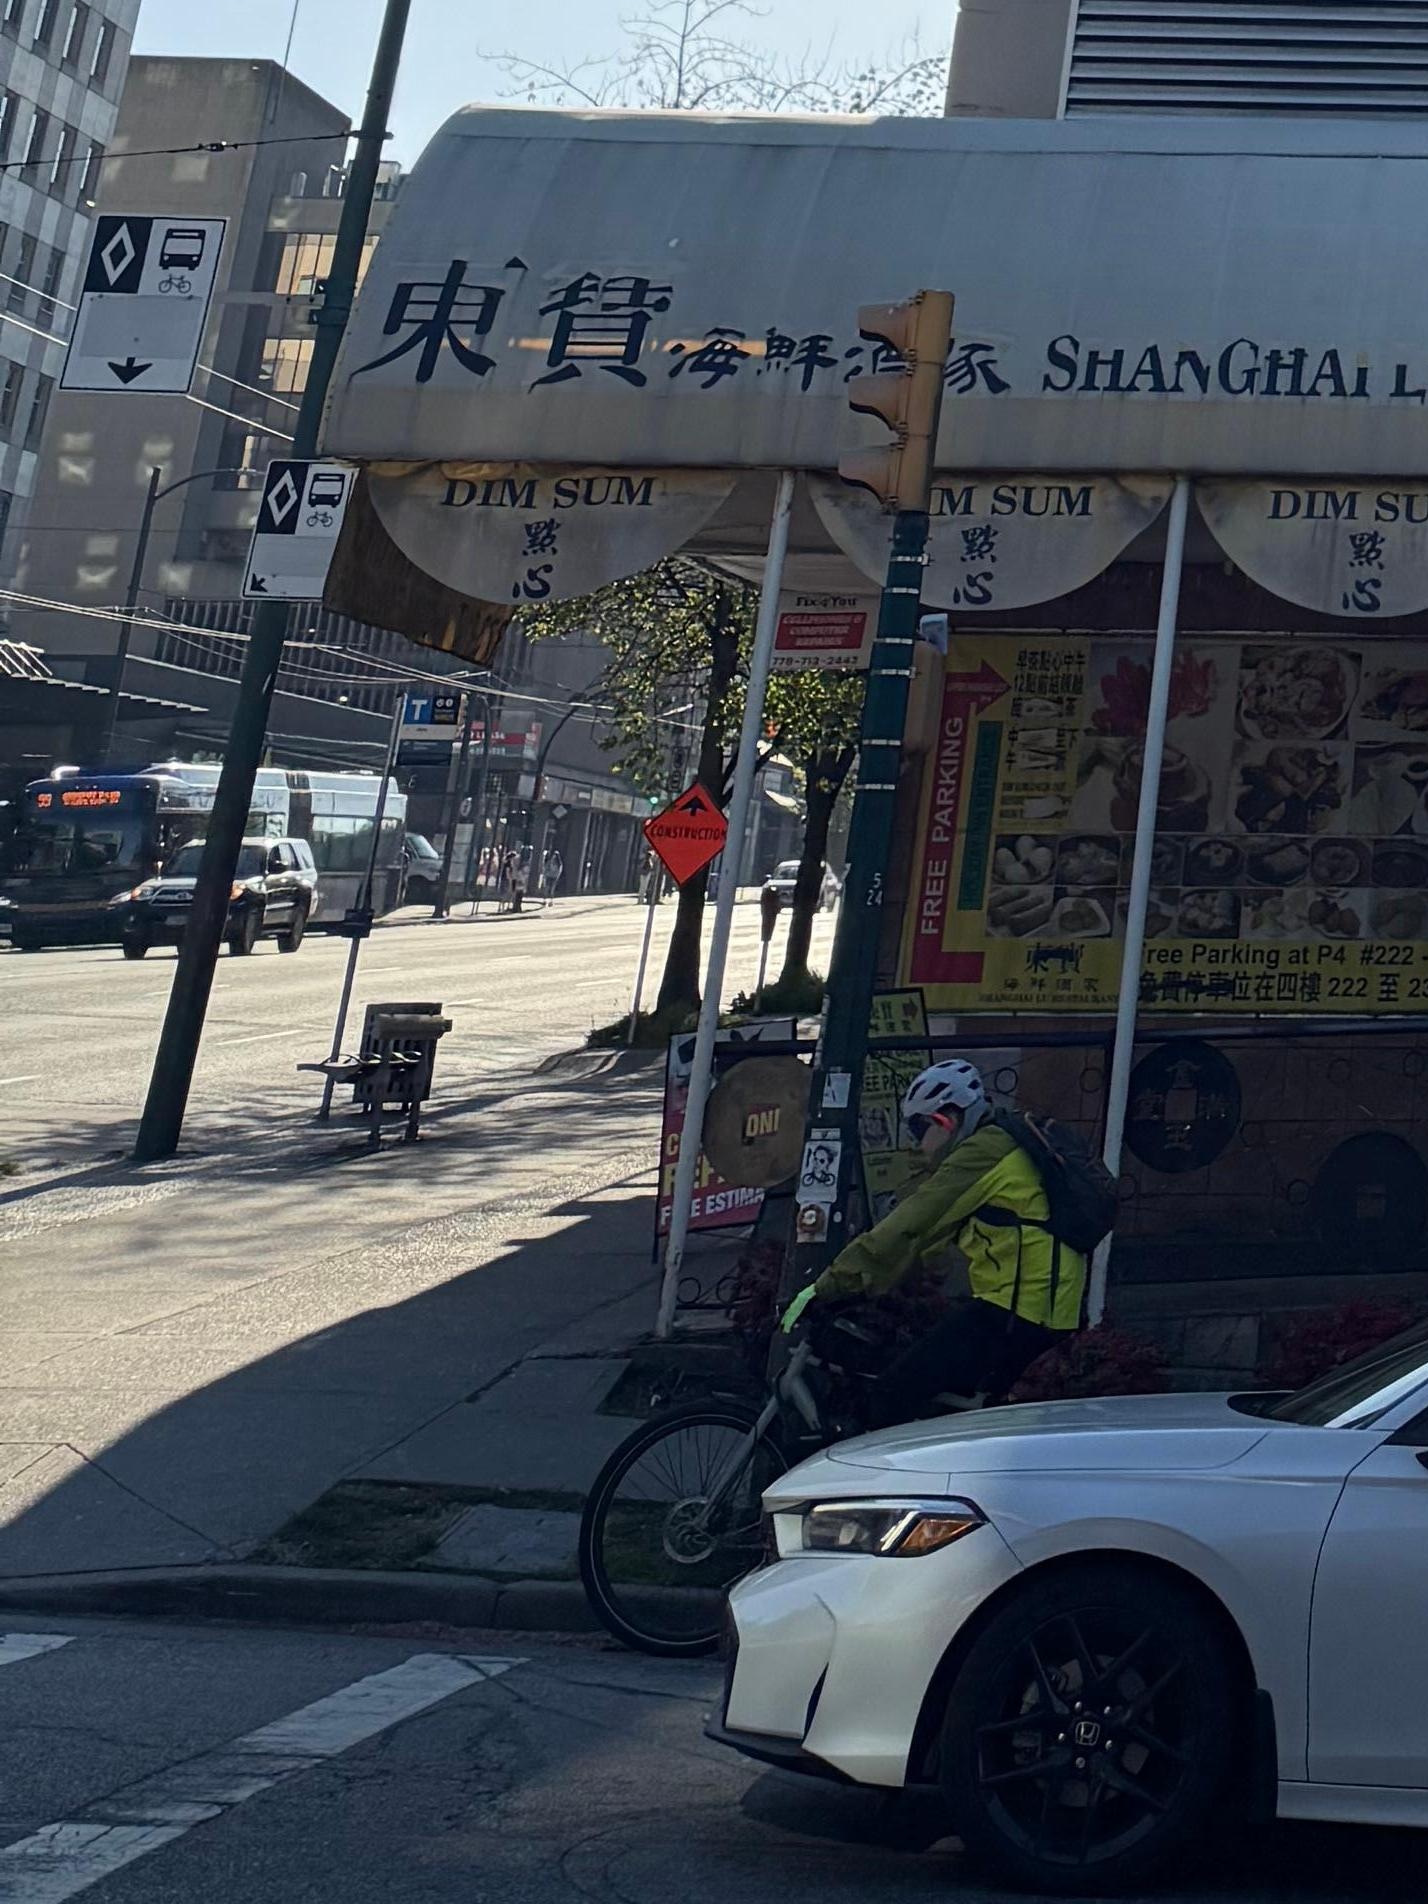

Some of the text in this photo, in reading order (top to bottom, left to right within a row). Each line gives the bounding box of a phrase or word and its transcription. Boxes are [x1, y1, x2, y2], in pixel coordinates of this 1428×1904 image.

[1043, 334, 1370, 399] SHANGHAI
[441, 477, 655, 509] DIM SUM
[991, 485, 1095, 517] SUM
[1267, 490, 1361, 520] DIM
[920, 716, 964, 935] FREE PARKING
[872, 872, 881, 889] 5
[1143, 943, 1184, 965] ree
[1191, 944, 1280, 970] Parking
[1288, 947, 1311, 965] at
[1317, 945, 1346, 965] P4
[1360, 946, 1414, 965] #222
[1328, 978, 1368, 998] 222
